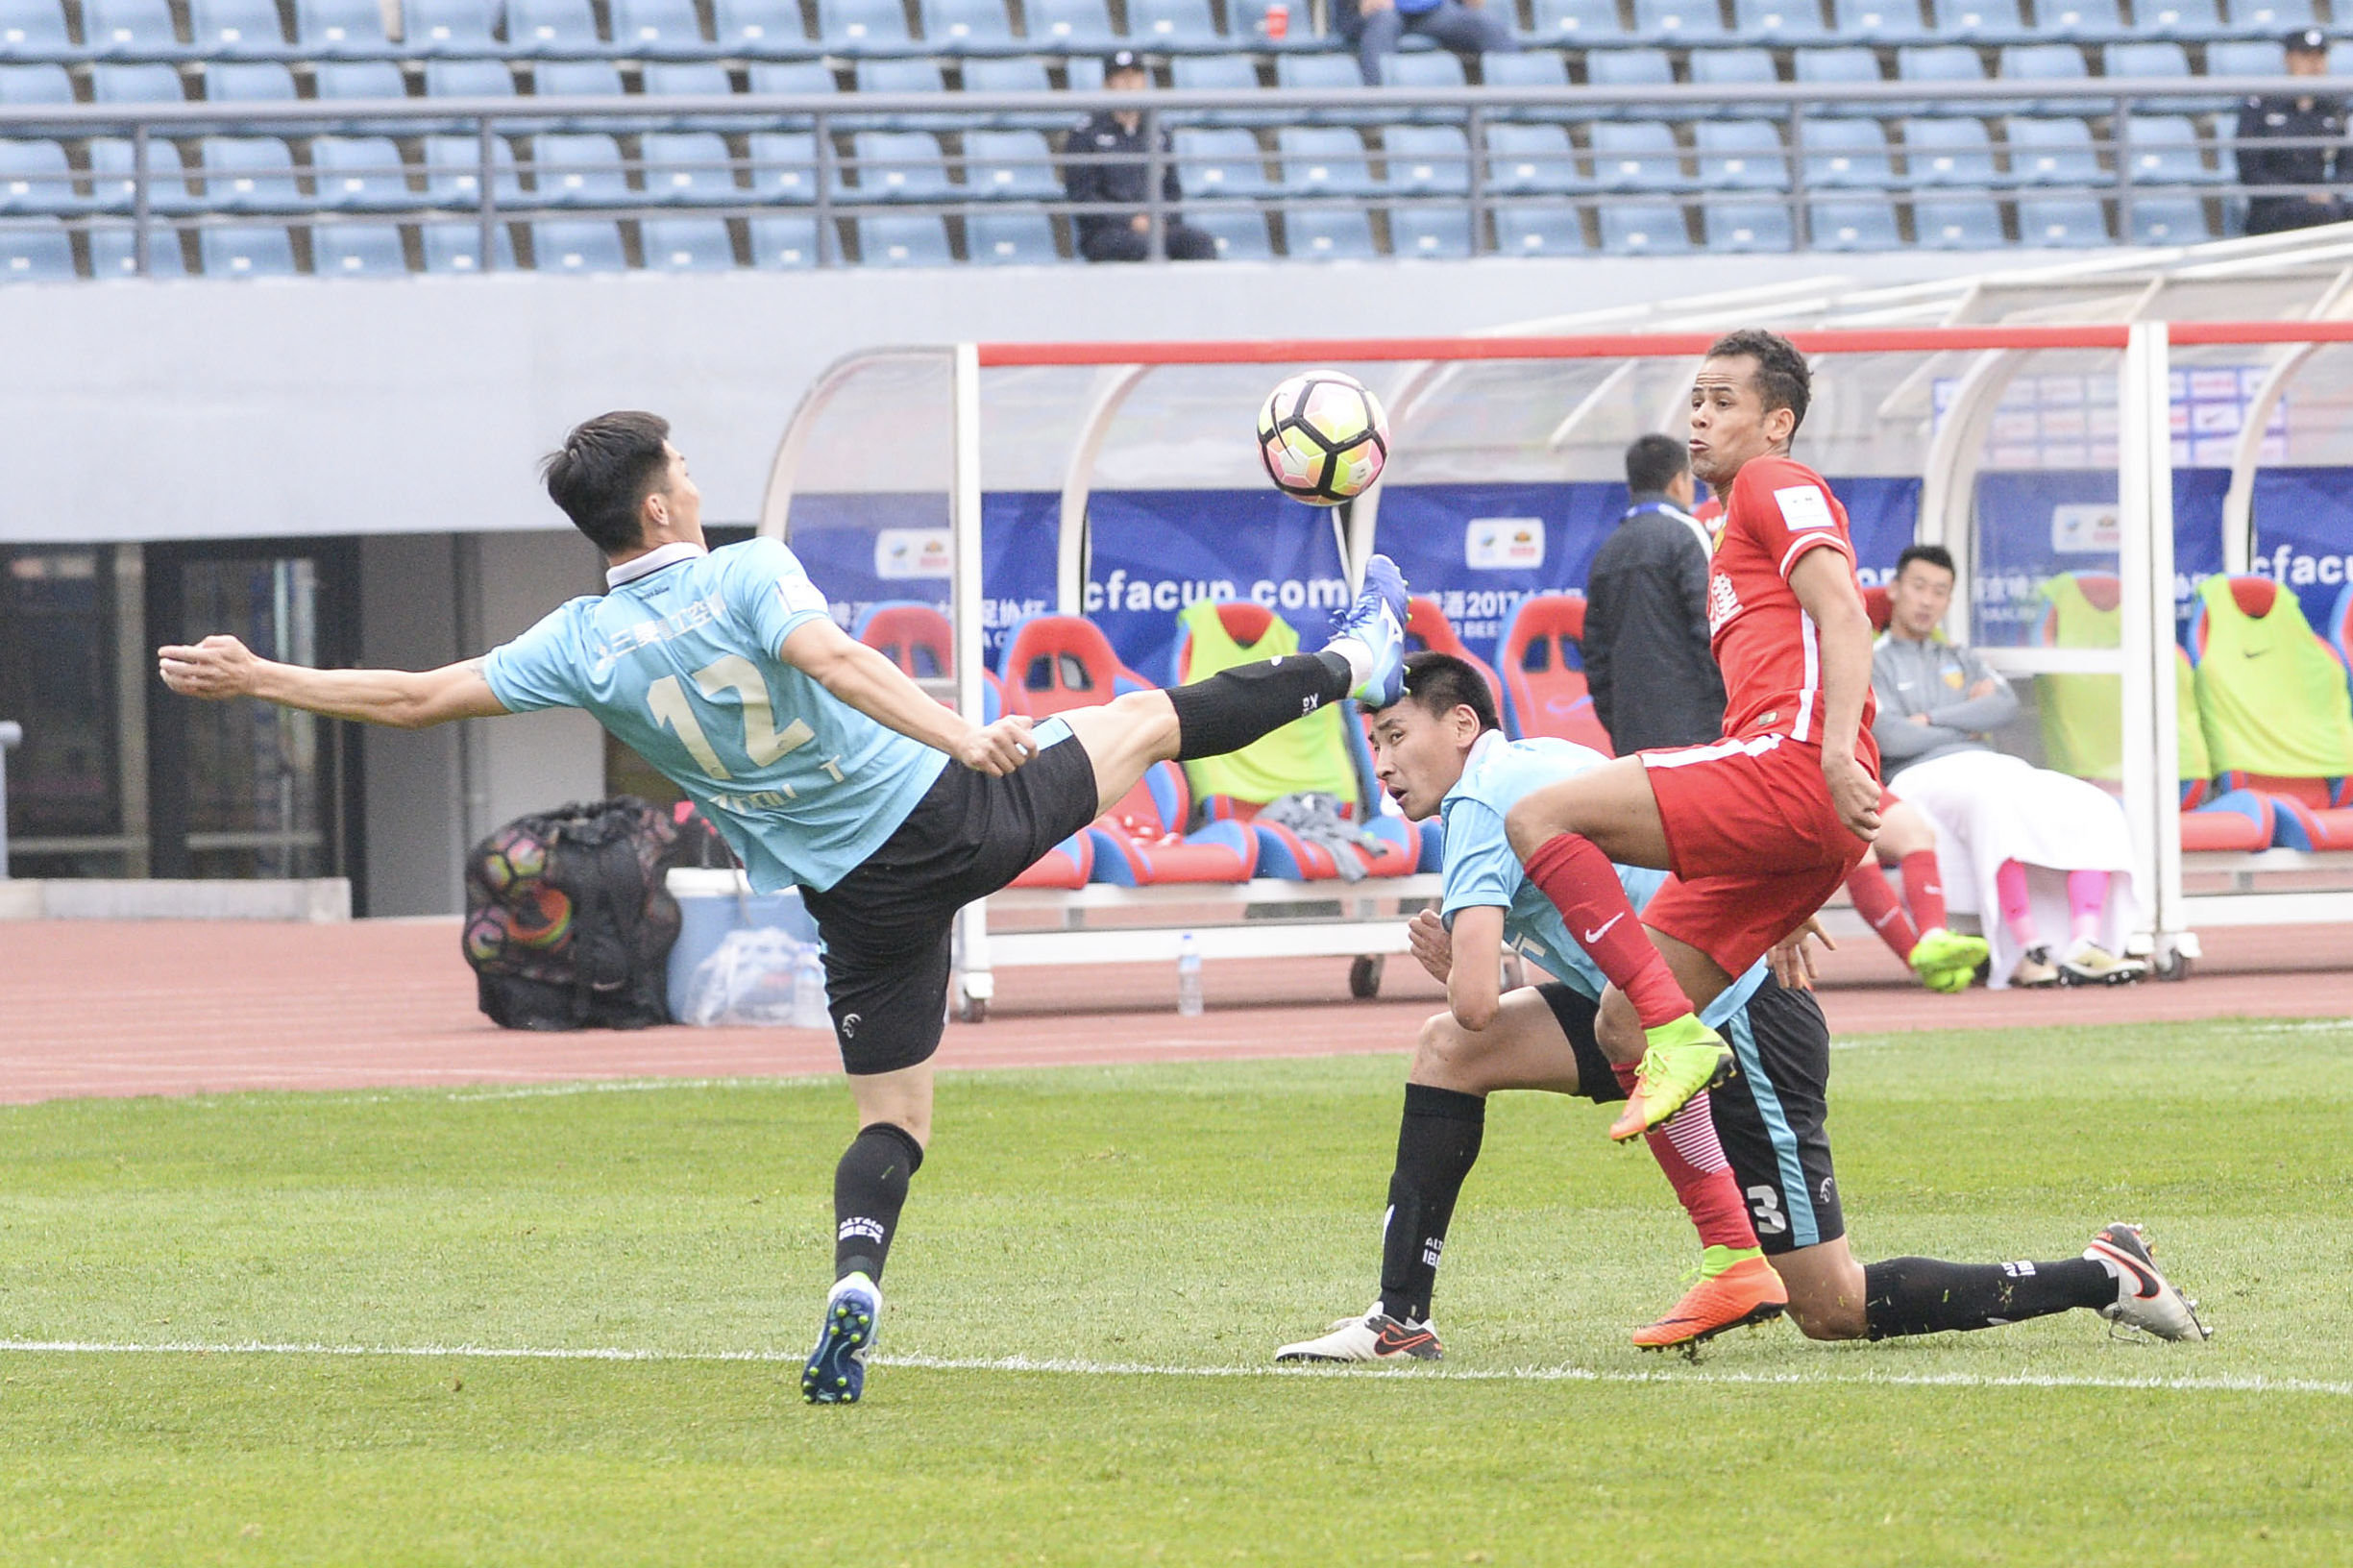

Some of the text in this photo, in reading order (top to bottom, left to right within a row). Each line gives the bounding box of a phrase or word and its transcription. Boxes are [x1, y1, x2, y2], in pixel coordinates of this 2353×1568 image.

[2251, 544, 2353, 586] cfac
[1084, 568, 1347, 612] cfacucom
[647, 653, 815, 780] 12
[1747, 1185, 1786, 1234] 3
